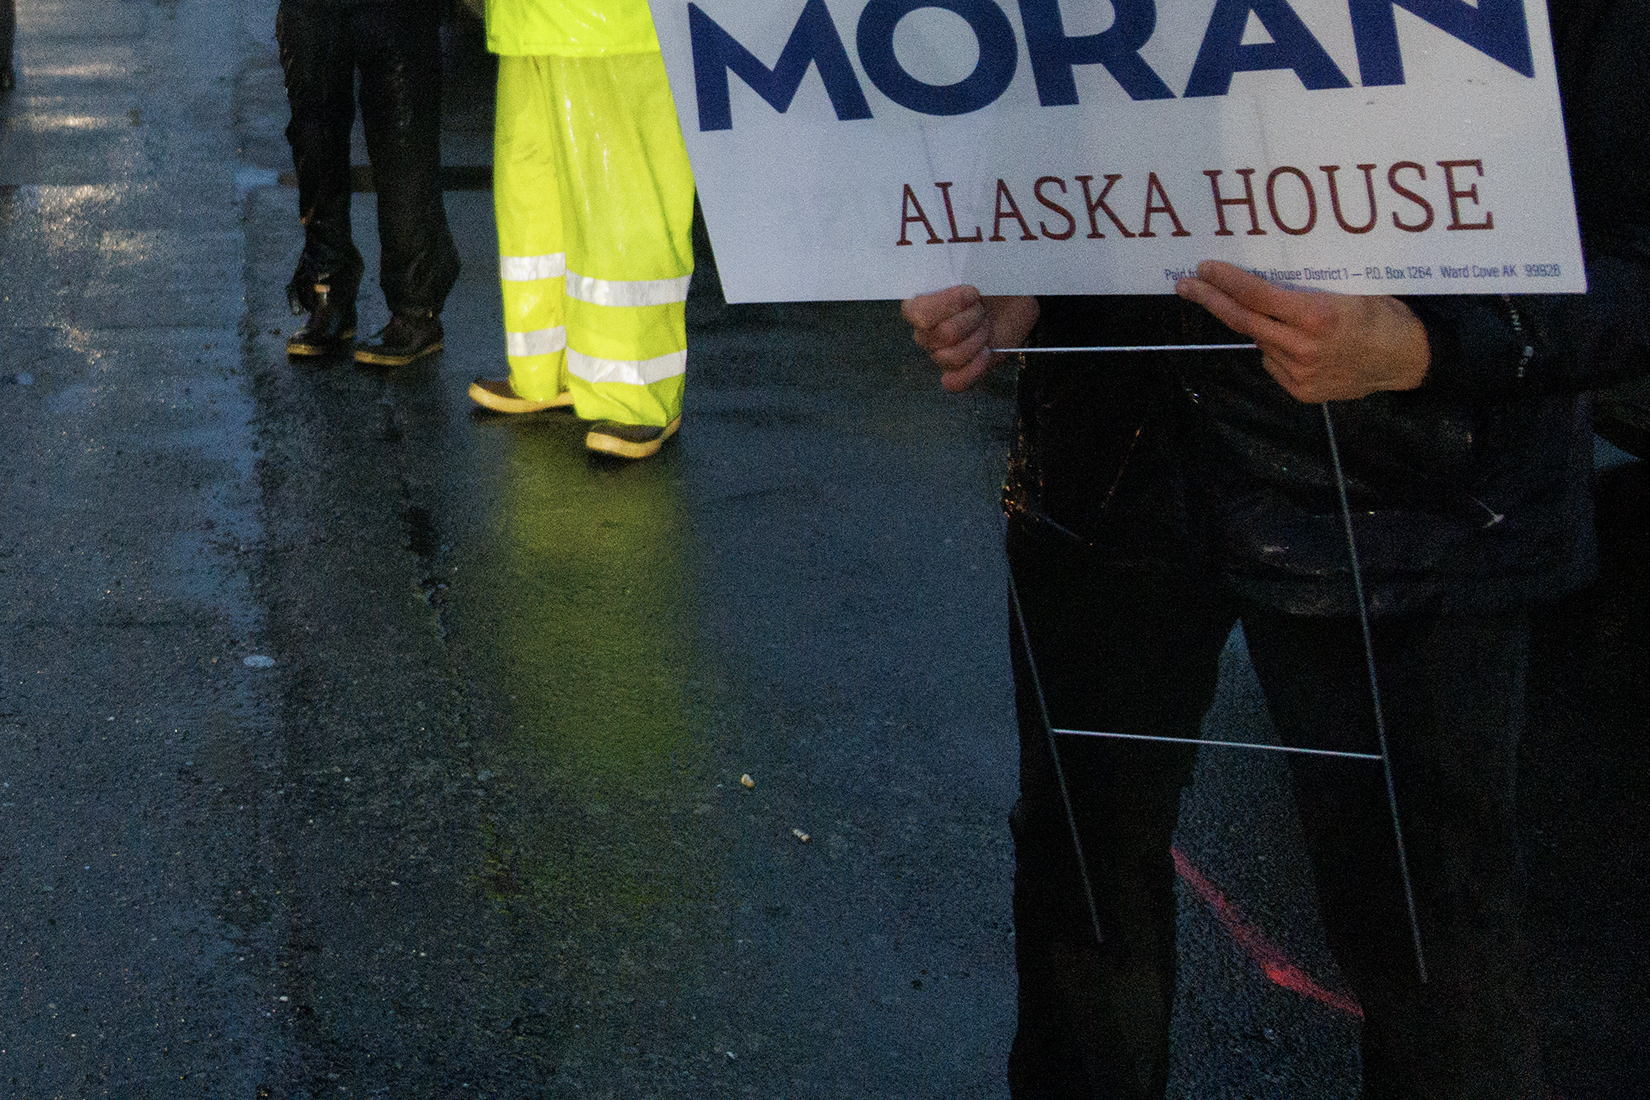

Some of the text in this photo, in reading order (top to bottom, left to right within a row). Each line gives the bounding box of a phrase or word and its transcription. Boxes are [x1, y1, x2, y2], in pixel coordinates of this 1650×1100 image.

[896, 158, 1495, 246] ALASKA HOUSE
[1269, 268, 1302, 281] House
[1304, 267, 1340, 281] District
[1365, 267, 1383, 280] P.O.
[1385, 267, 1406, 280] Box
[1407, 266, 1432, 279] 1264
[1440, 265, 1470, 279] Ward
[1472, 265, 1499, 278] Cove
[1502, 264, 1517, 277] AK
[1525, 263, 1561, 277] 99928
